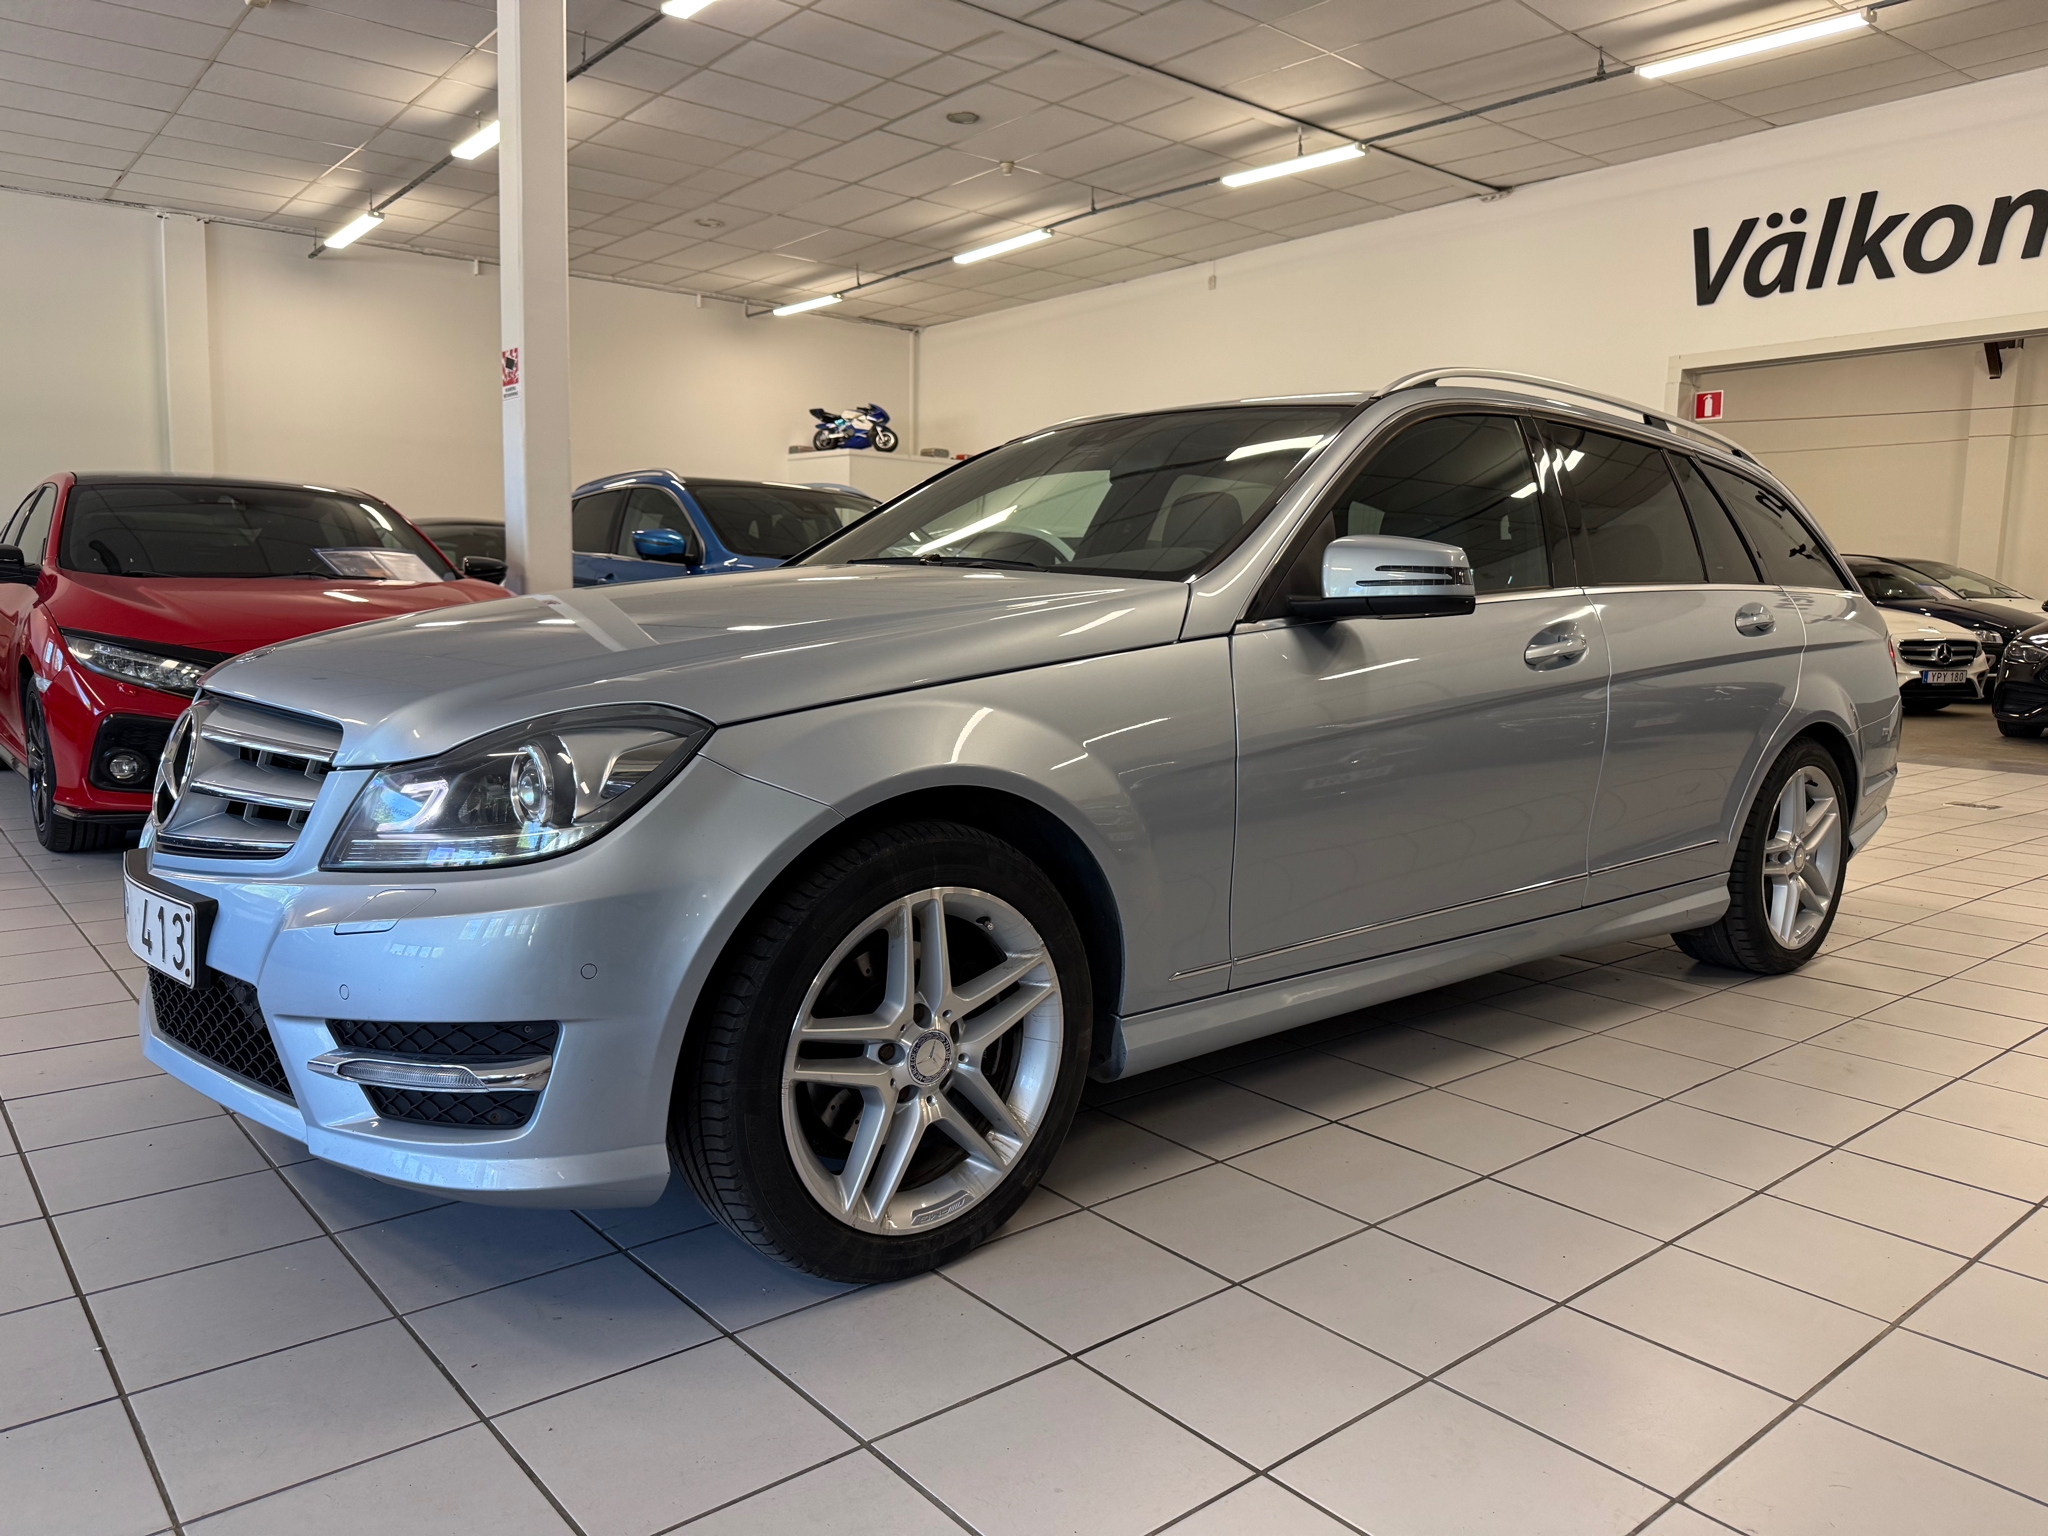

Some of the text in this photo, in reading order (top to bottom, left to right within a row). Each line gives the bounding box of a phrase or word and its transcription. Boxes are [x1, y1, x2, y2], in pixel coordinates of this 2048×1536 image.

[1931, 672, 1964, 682] YPY 180
[141, 898, 186, 972] 413
